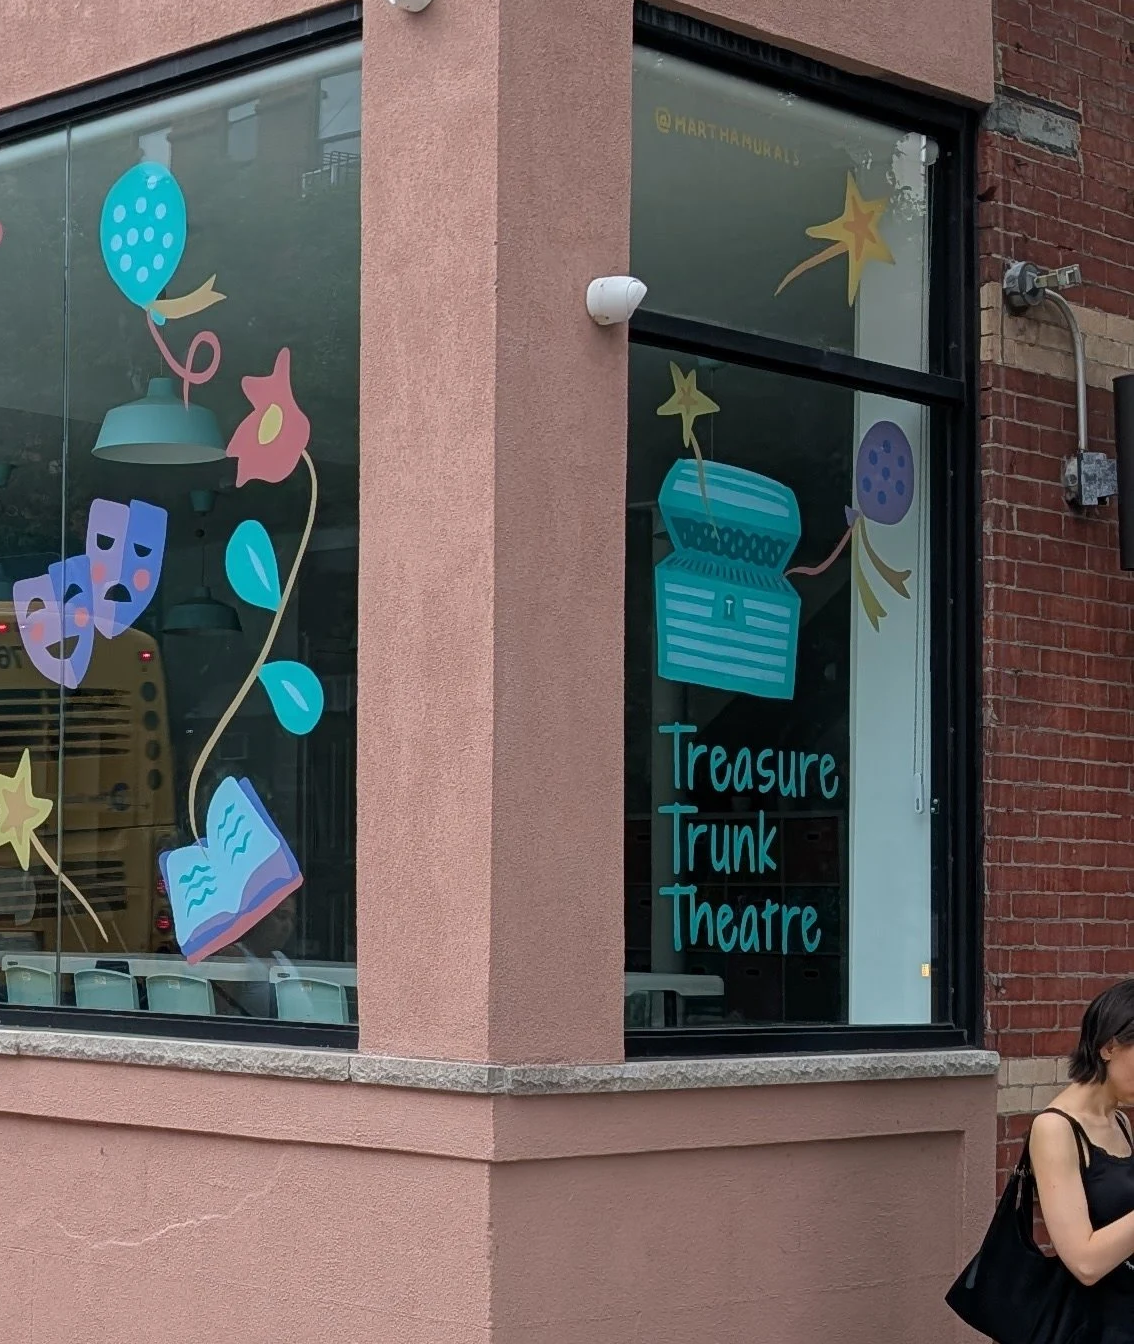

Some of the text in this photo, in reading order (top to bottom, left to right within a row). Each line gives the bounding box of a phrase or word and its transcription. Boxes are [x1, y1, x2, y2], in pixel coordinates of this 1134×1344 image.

[654, 106, 802, 168] @MARTHAMURALS
[658, 721, 839, 799] Treasure
[657, 801, 777, 875] Trunk
[658, 882, 822, 955] Theatre
